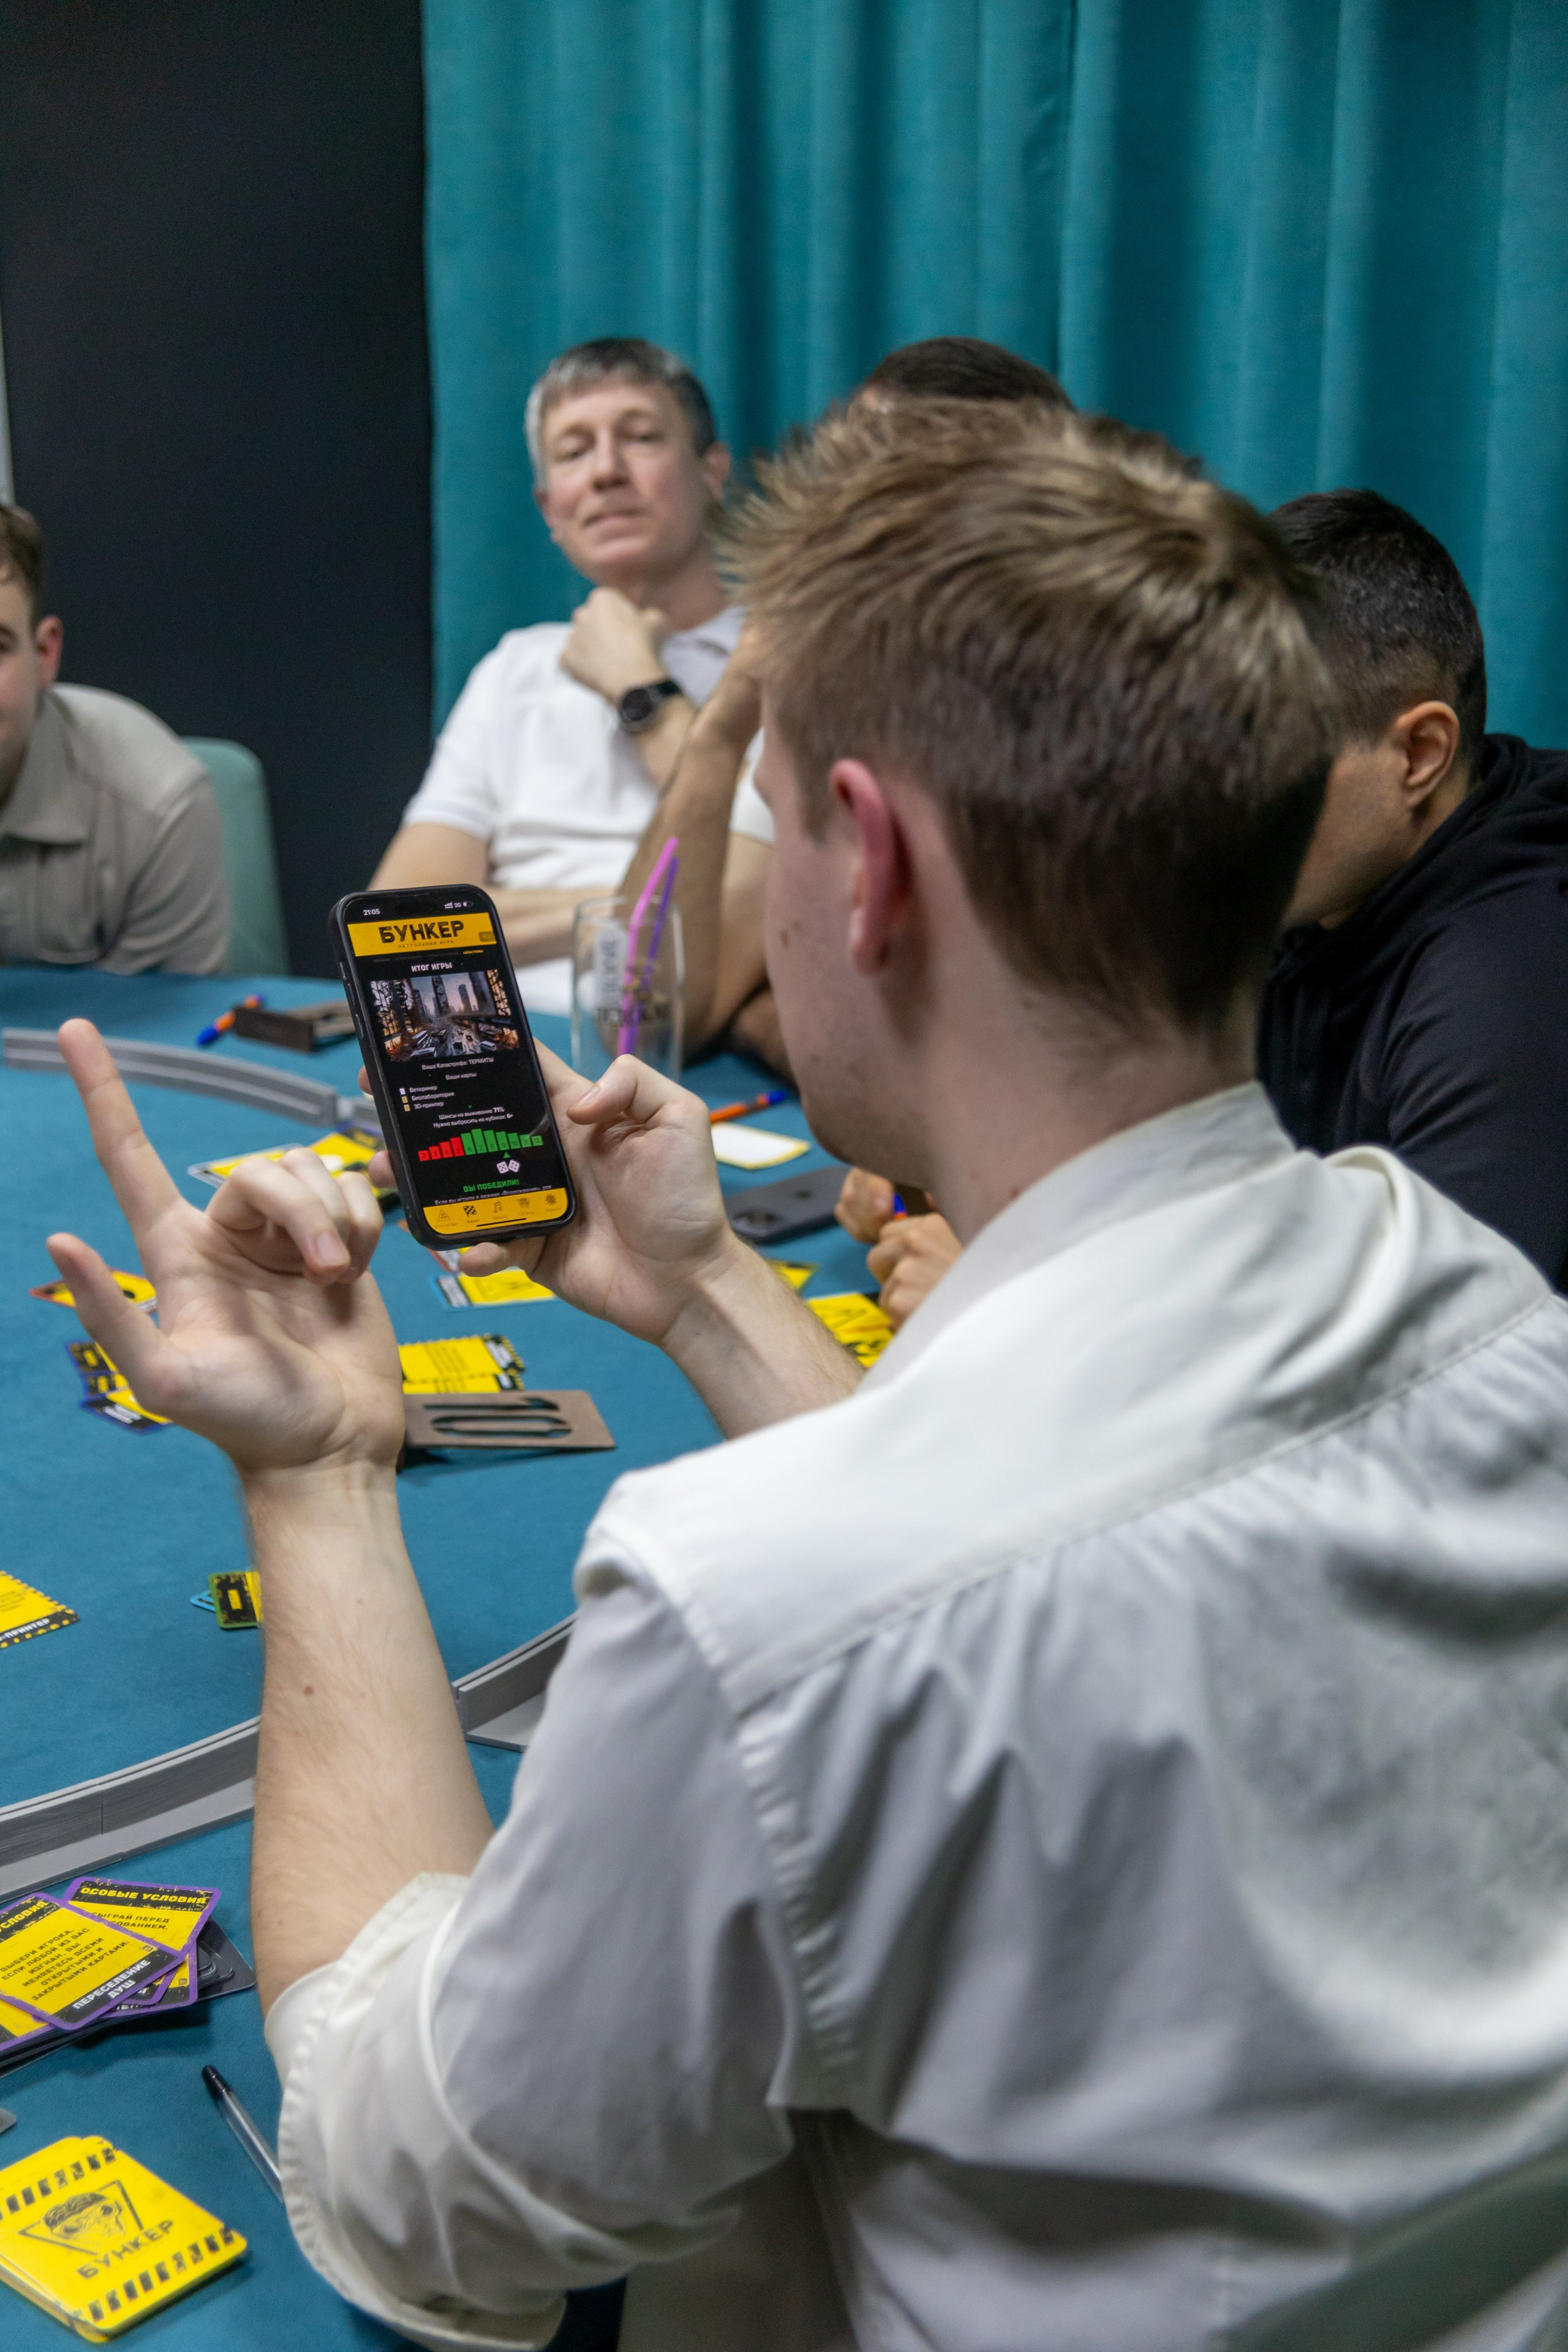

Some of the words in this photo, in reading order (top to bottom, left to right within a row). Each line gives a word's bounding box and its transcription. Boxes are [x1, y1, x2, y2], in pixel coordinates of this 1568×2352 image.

[379, 921, 464, 944] БУНКЕР
[411, 964, 429, 973] ИТОГ
[431, 962, 453, 971] ИГРЫ
[412, 1092, 454, 1101] Биолаборатория
[451, 1118, 478, 1127] выбросить
[477, 1179, 519, 1191] ПОБЕДИЛИ!
[80, 1887, 138, 1899] ОСОБЫЕ
[143, 1893, 207, 1904] УСЛОВИЯ
[0, 1901, 48, 1932] СЛОВИЯ
[1, 1950, 37, 1973] ВЫБЕРИ
[39, 1929, 75, 1951] ИГРОКА.
[1, 1965, 26, 1981] ЕСЛИ
[26, 1947, 58, 1967] ЛЮБОЙ
[58, 1939, 71, 1948] ИЗ
[70, 1928, 90, 1940] ВАС
[65, 1943, 80, 1953] ВЫ
[22, 1956, 74, 1987] МЕНЯЕТЕСЬ
[74, 1937, 104, 1957] ВСЕМИ
[31, 1966, 88, 2002] ЗАКРЫТЫМИ
[88, 1940, 130, 1968] КАРТАМИ.
[40, 1954, 97, 1986] ОТКРЫТЫМИ
[72, 1959, 151, 2010] ПЕРЕСЕЛЕНИЕ
[107, 1980, 136, 1999] ДУШ
[77, 2220, 173, 2279] БУНКЕР
